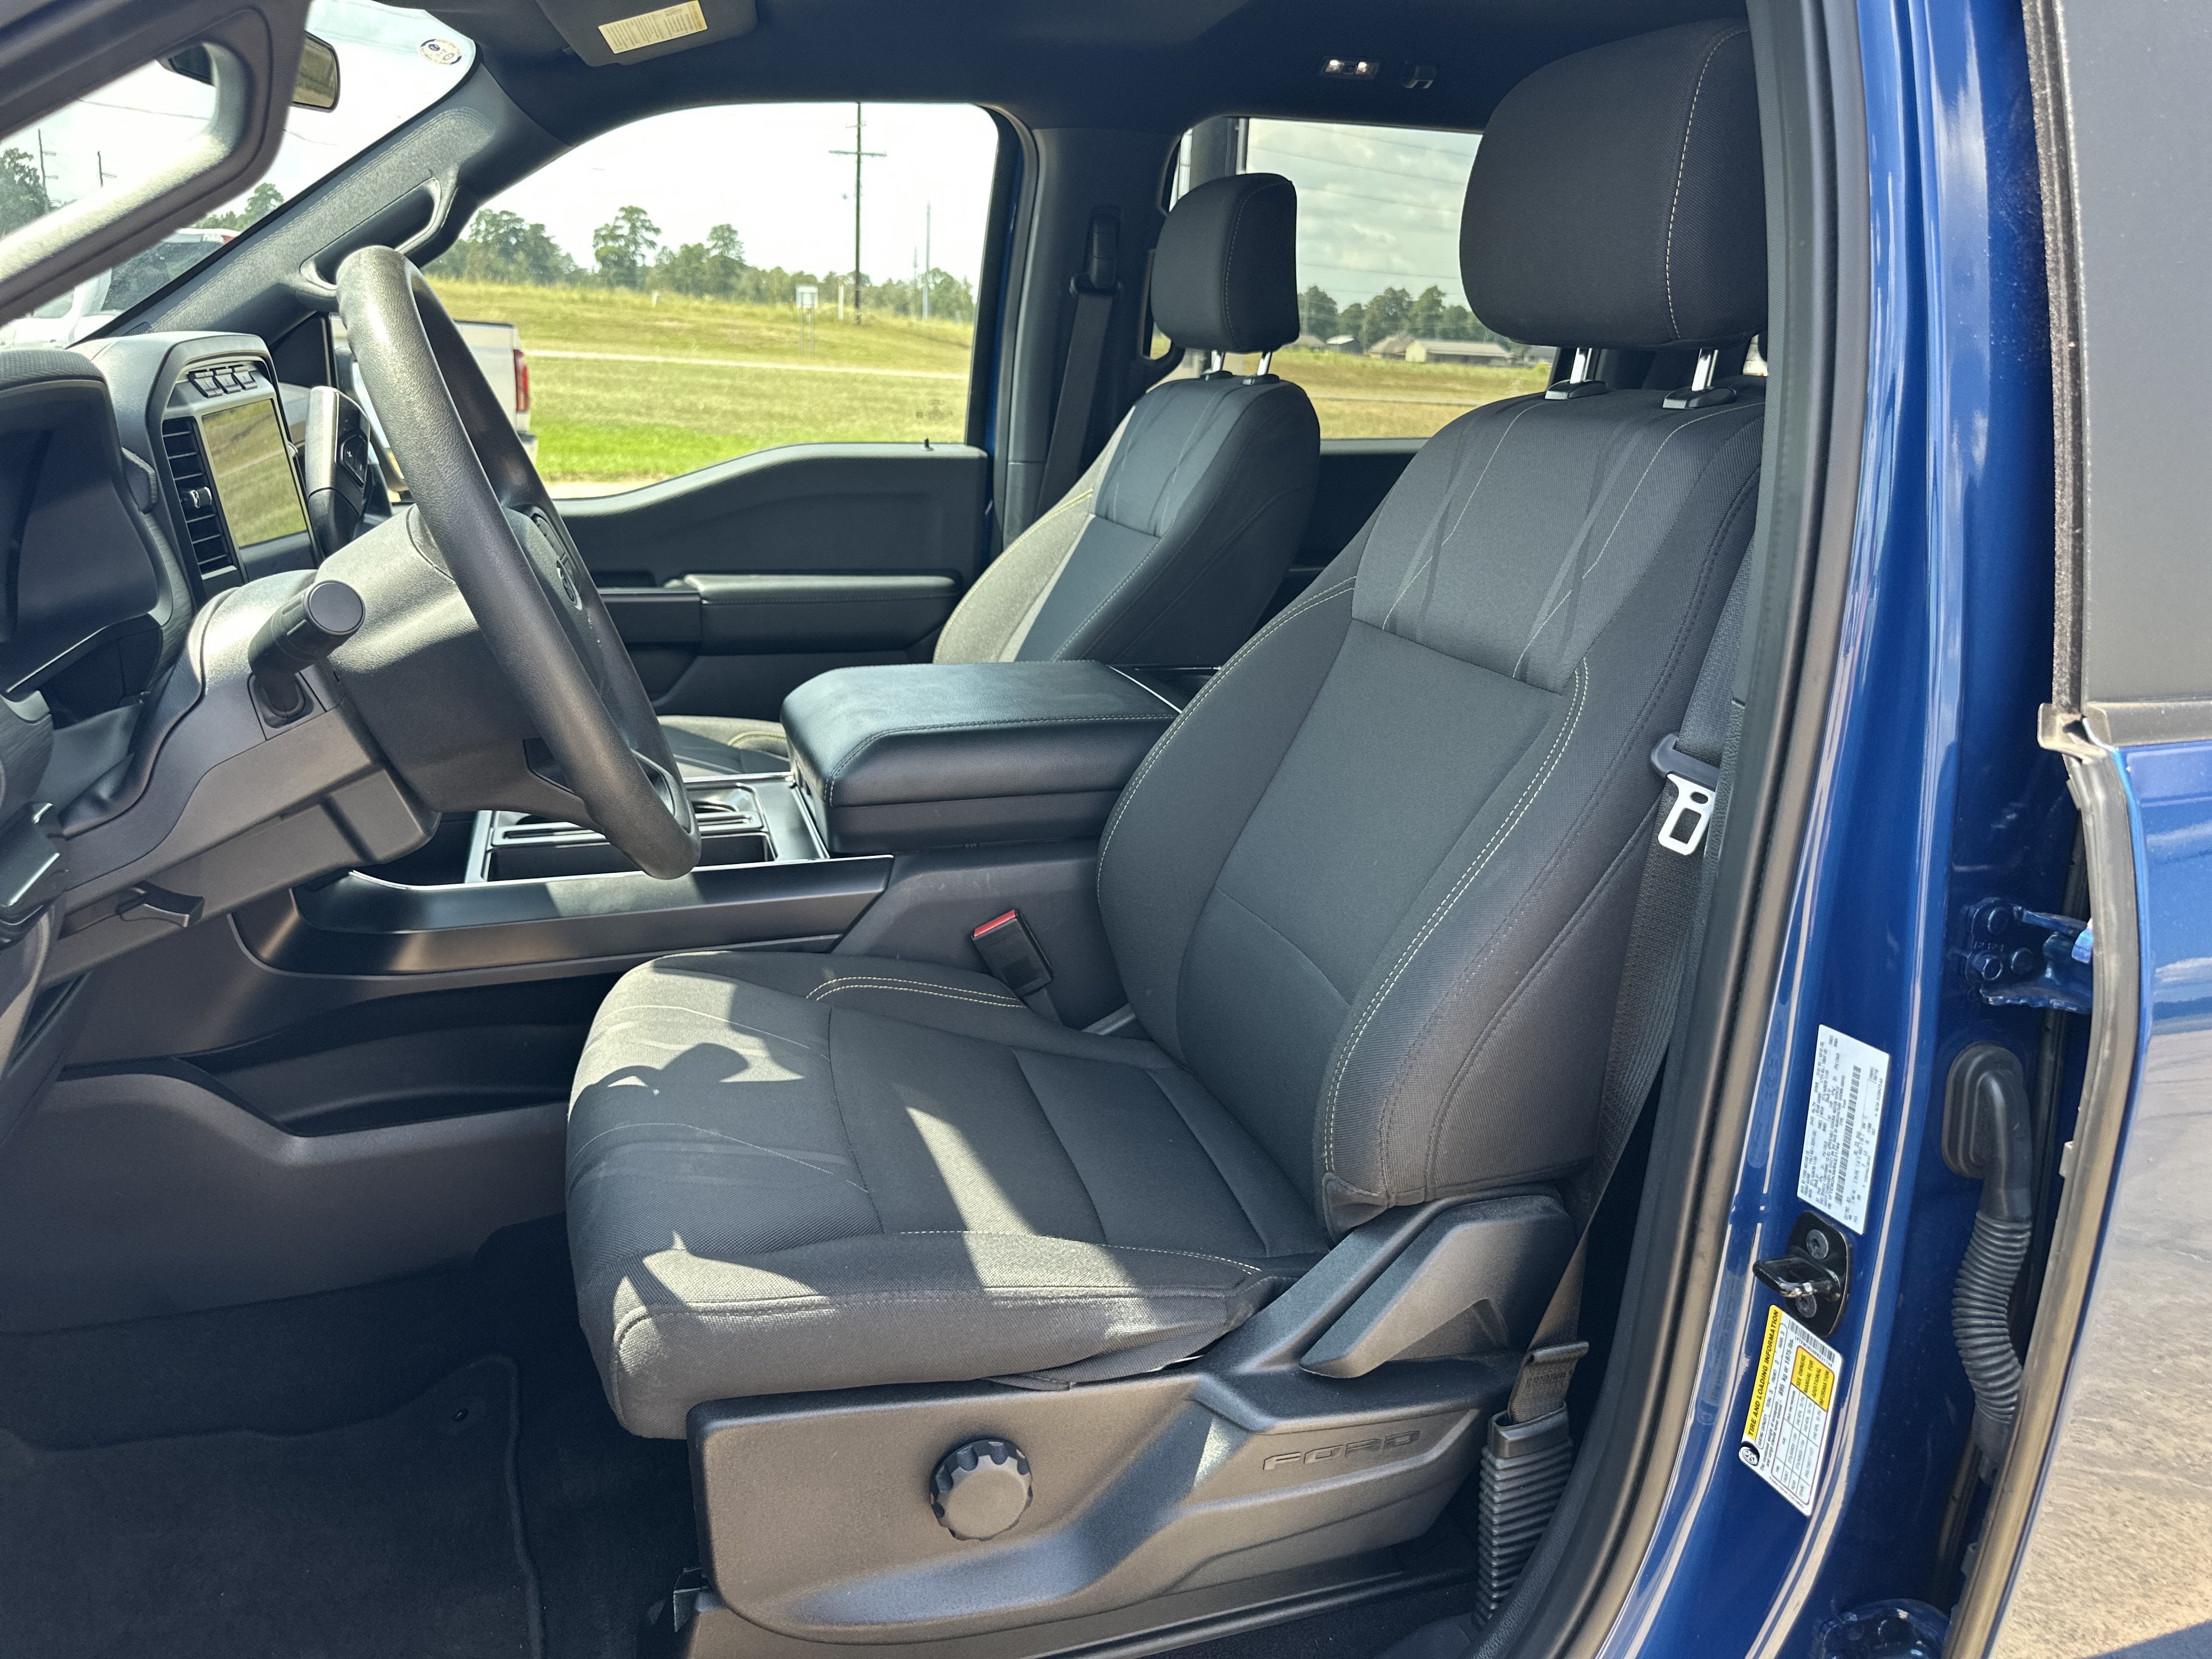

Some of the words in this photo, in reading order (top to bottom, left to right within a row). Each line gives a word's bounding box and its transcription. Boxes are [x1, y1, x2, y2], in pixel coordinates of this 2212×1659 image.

[1757, 1364, 1768, 1400] LOADING
[1764, 1310, 1779, 1364] INFORMATION
[1781, 1372, 1787, 1383] kg
[1803, 1371, 1812, 1394] MANUAL
[1811, 1366, 1821, 1399] ADDITIONAL
[1819, 1369, 1830, 1407] INFORMATION
[1262, 1430, 1420, 1470] FORD
